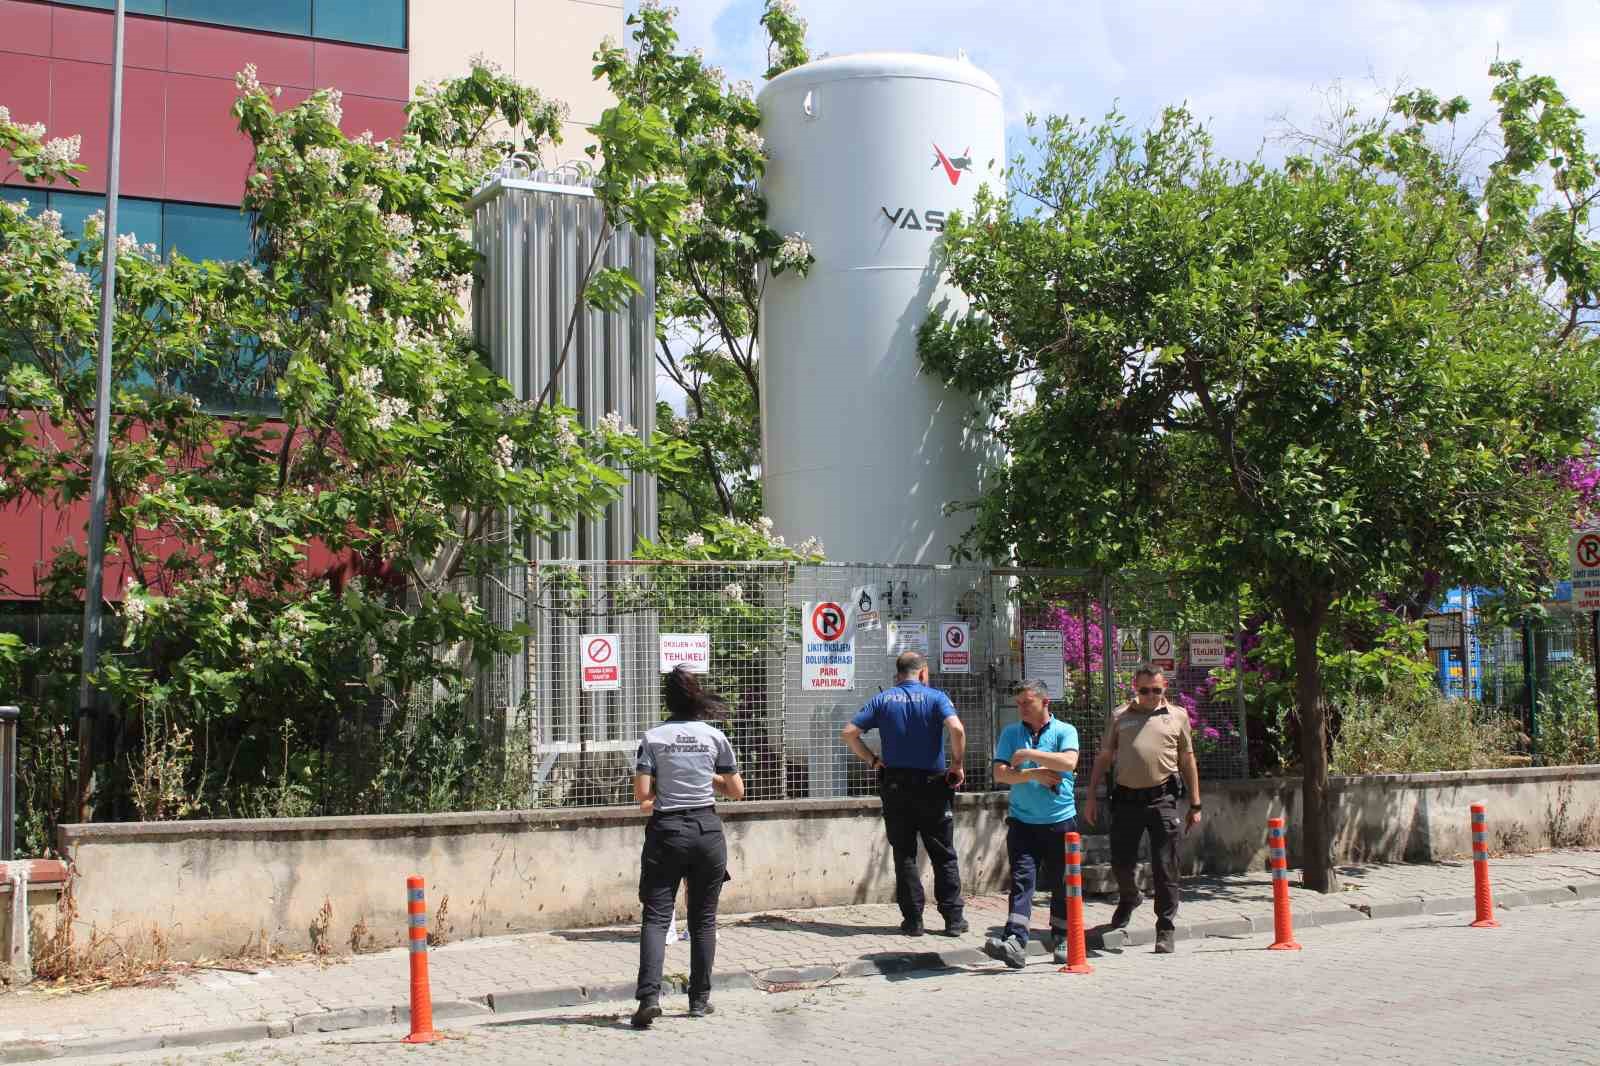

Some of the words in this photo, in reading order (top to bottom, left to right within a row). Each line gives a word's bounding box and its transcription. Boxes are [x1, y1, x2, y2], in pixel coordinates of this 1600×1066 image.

[805, 655, 827, 665] DOLUM
[829, 655, 853, 665] SAHASI
[819, 667, 839, 676] PARK
[811, 679, 846, 687] YAPILMAZ
